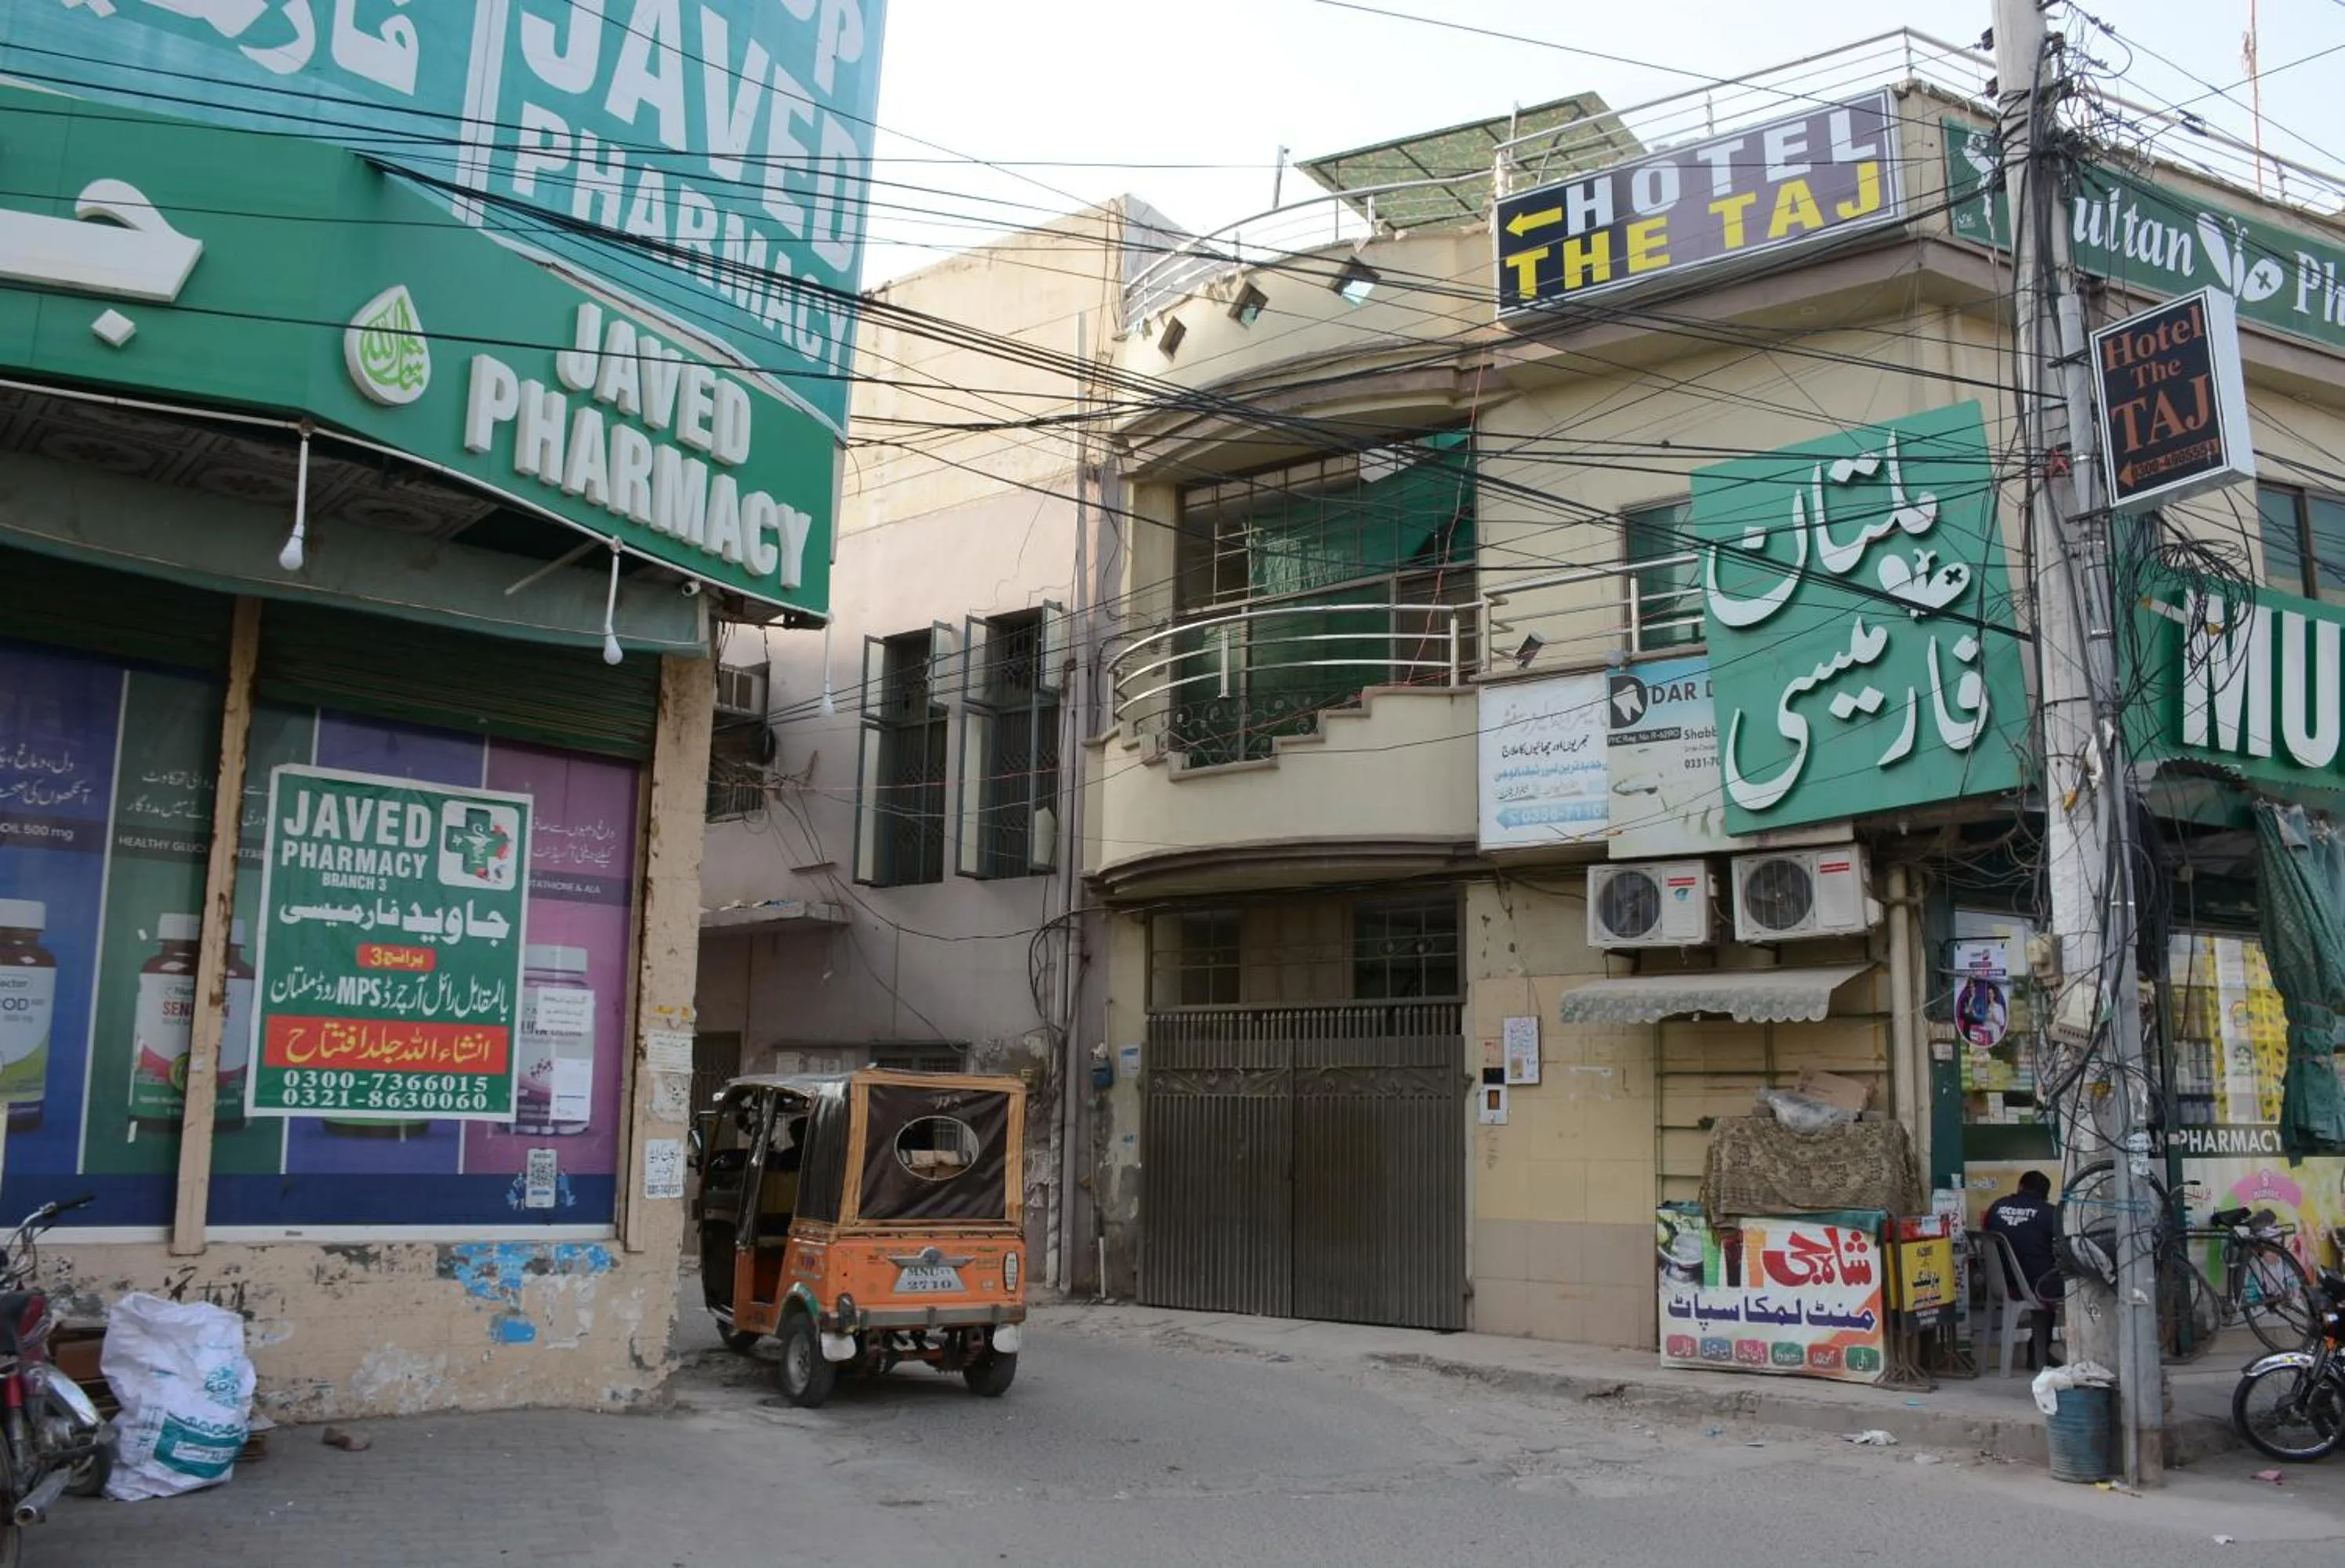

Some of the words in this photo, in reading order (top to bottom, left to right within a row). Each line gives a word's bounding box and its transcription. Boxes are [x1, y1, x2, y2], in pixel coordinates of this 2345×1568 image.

[521, 0, 859, 272] JAVED
[1566, 108, 1877, 236] HOTEL
[512, 101, 852, 376] PHARMACY
[1506, 215, 1672, 300] THE
[1708, 161, 1882, 250] TAJ
[2102, 304, 2204, 372] Hotel
[556, 302, 752, 466] JAVED
[2130, 358, 2184, 390] The
[2110, 372, 2210, 454] TAJ
[464, 354, 812, 589] PHARMACY
[1707, 427, 1938, 626] ملتان
[1652, 682, 1697, 704] DAR
[1726, 616, 1989, 811] فارمیسی
[283, 789, 432, 849] JAVED
[281, 839, 429, 880] PHARMACY
[322, 872, 376, 891] BRANCH
[378, 877, 387, 892] 3
[279, 898, 400, 931] فارمیسی
[402, 899, 510, 948] جاوید
[370, 946, 383, 966] 3
[336, 975, 381, 1007] MPS
[282, 1088, 487, 1109] 0321-8630060
[283, 1069, 488, 1092] 0300-7366015
[2179, 1128, 2281, 1153] PHARMACY
